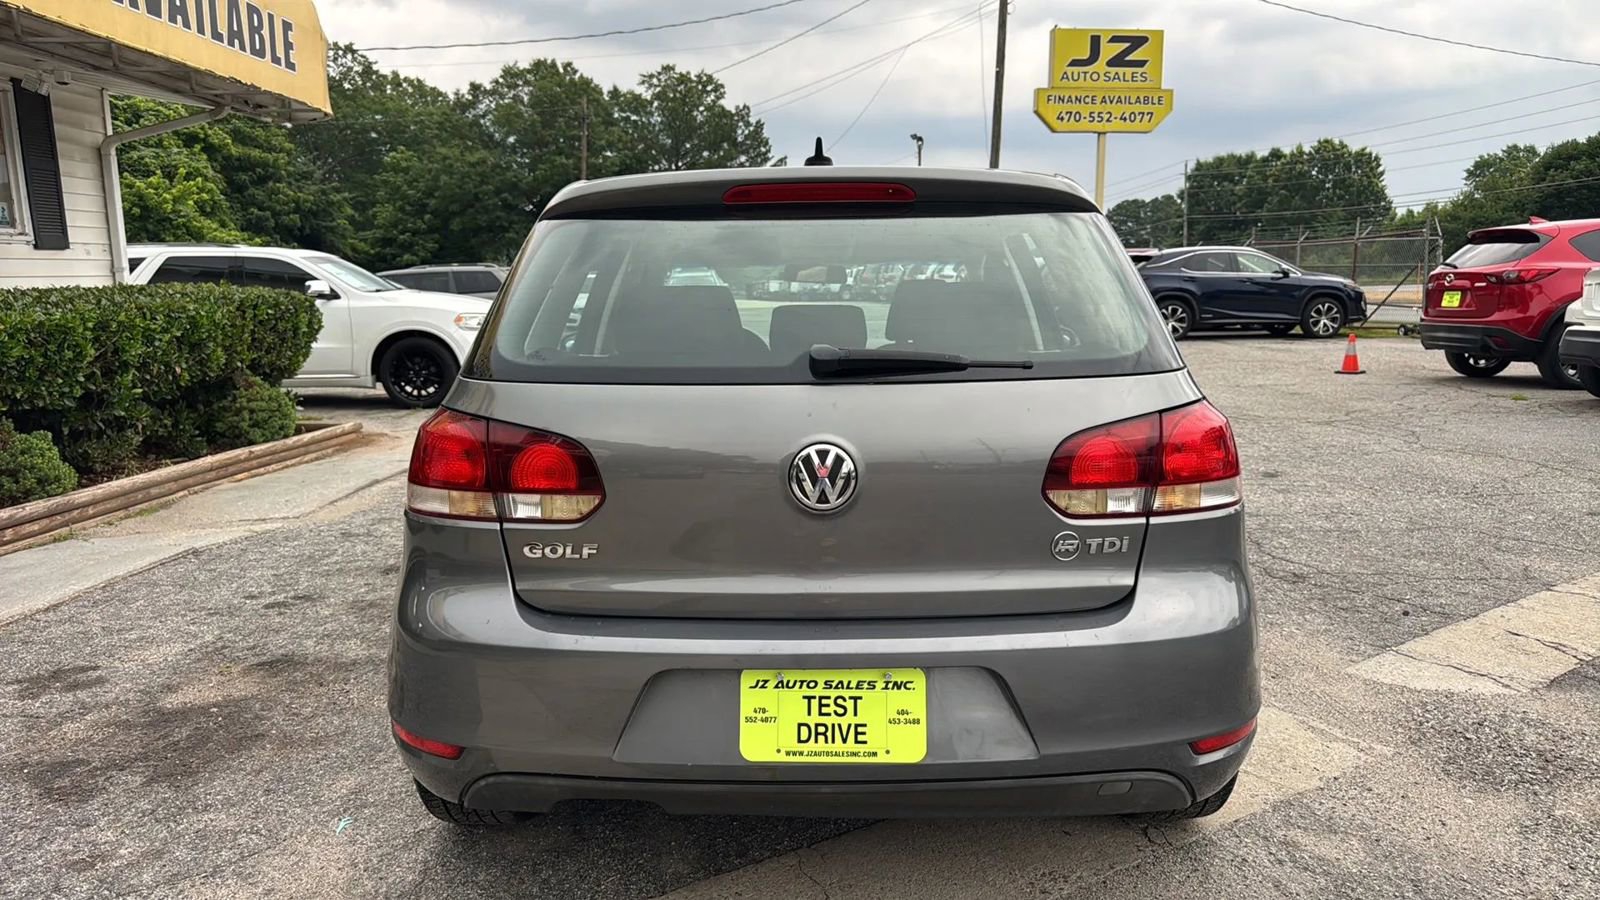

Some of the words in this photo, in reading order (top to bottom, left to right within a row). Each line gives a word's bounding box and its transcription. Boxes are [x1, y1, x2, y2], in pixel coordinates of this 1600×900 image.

[1066, 34, 1150, 68] JZ
[1060, 71, 1100, 82] AUTO
[1103, 71, 1148, 82] SALES
[1047, 95, 1097, 105] FINANCE
[1101, 95, 1165, 106] AVAILABLE
[1056, 111, 1154, 124] 470-552-4077
[790, 443, 857, 510] VW
[523, 542, 598, 559] GOLF
[749, 679, 770, 689] JZ
[773, 679, 818, 690] AUTO
[822, 680, 877, 690] SALES
[881, 680, 916, 691] INC.
[802, 695, 863, 717] TEST
[896, 708, 912, 716] 404-
[797, 723, 867, 744] DRIVE
[785, 750, 878, 758] WWW.JZAUTOSALESINC.COM
